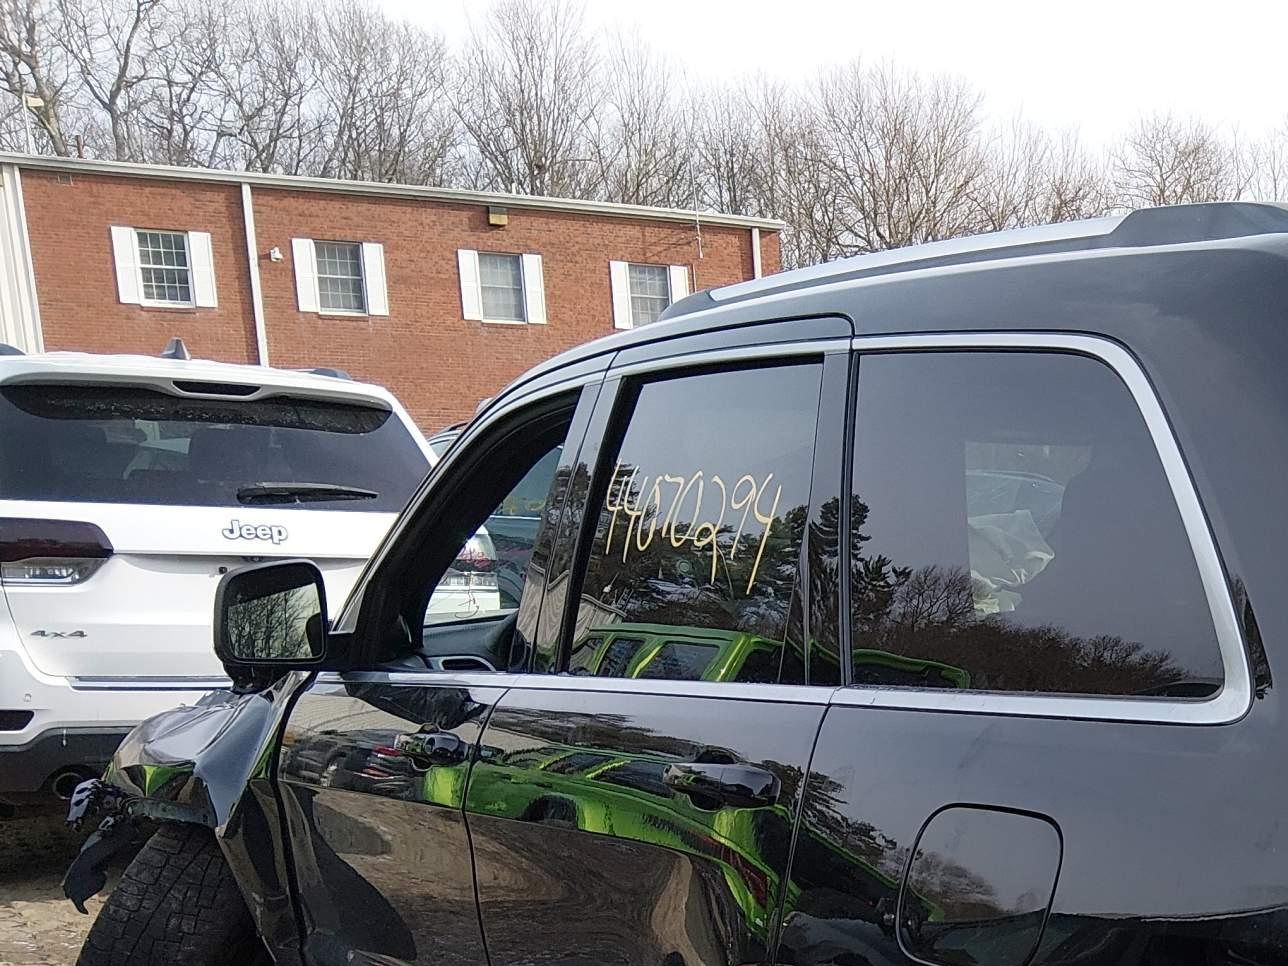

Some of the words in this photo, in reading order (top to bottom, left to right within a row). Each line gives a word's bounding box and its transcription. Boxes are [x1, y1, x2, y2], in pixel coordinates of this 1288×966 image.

[221, 519, 289, 545] Jeep
[606, 457, 782, 595] 44070294
[30, 629, 88, 638] 4x4
